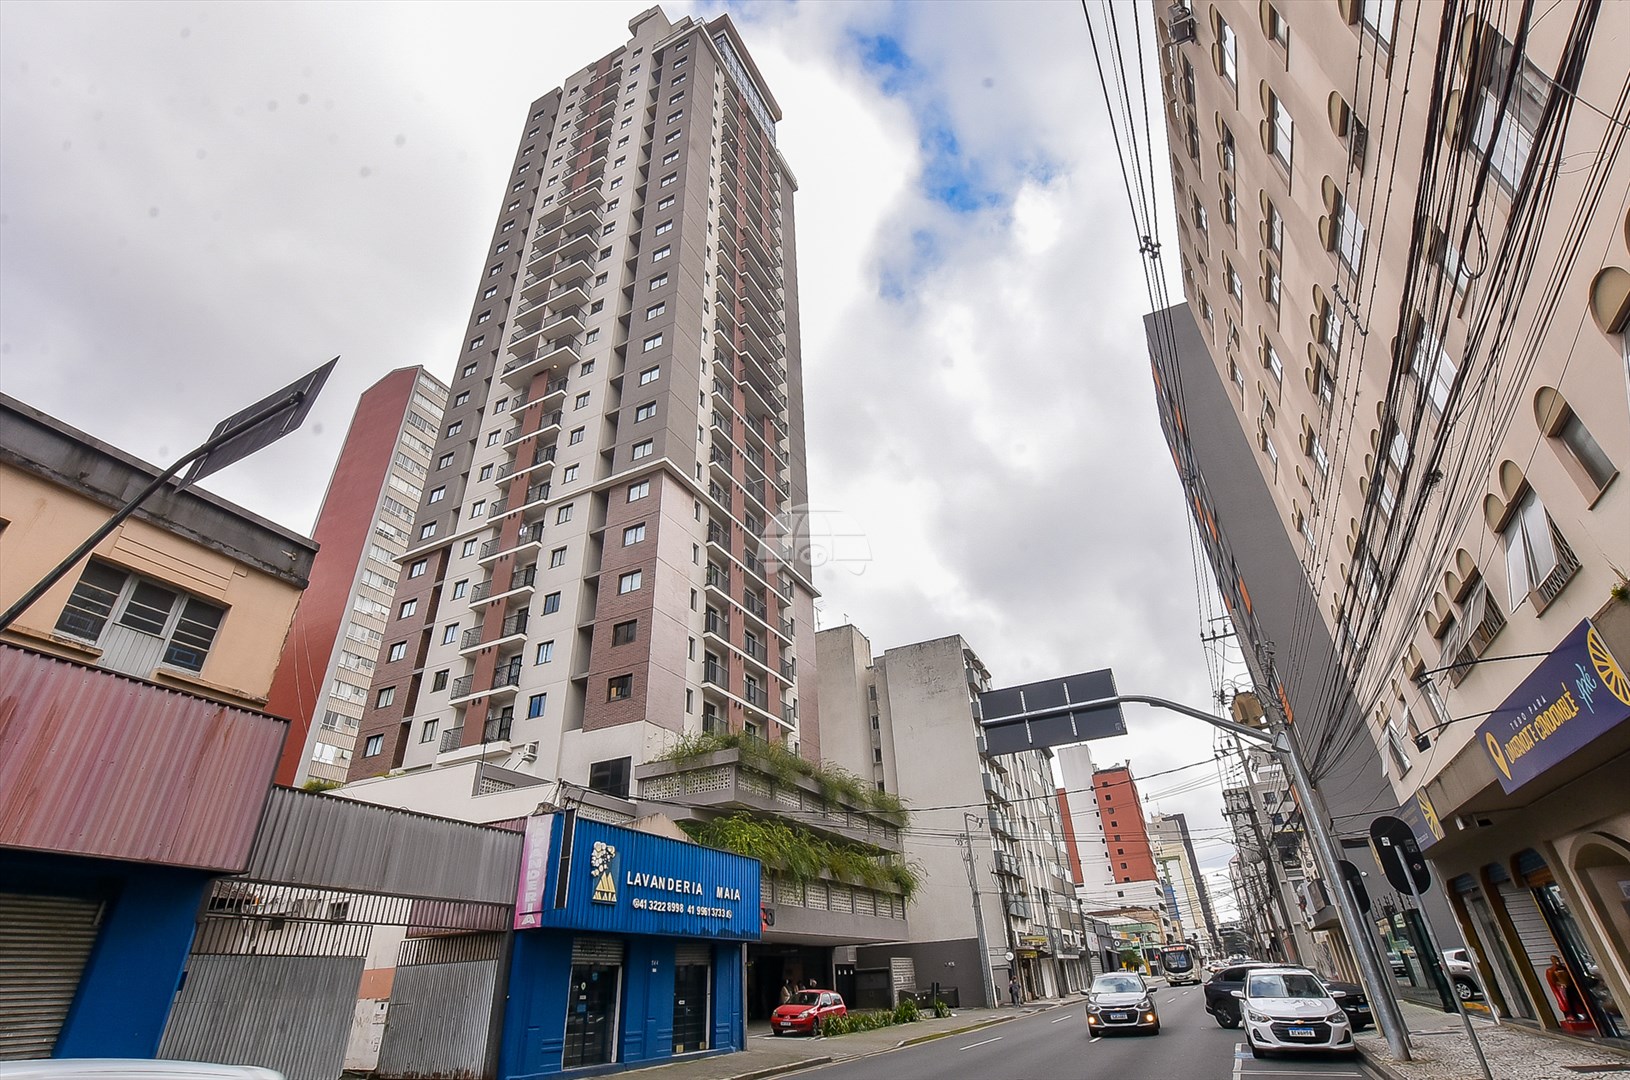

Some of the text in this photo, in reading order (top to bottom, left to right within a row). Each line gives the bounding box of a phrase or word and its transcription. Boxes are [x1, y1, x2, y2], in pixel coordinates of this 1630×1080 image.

[1509, 695, 1547, 730] TUDO PARA
[592, 891, 617, 902] MAIA
[627, 871, 741, 901] LAVANDERIA MAIA
